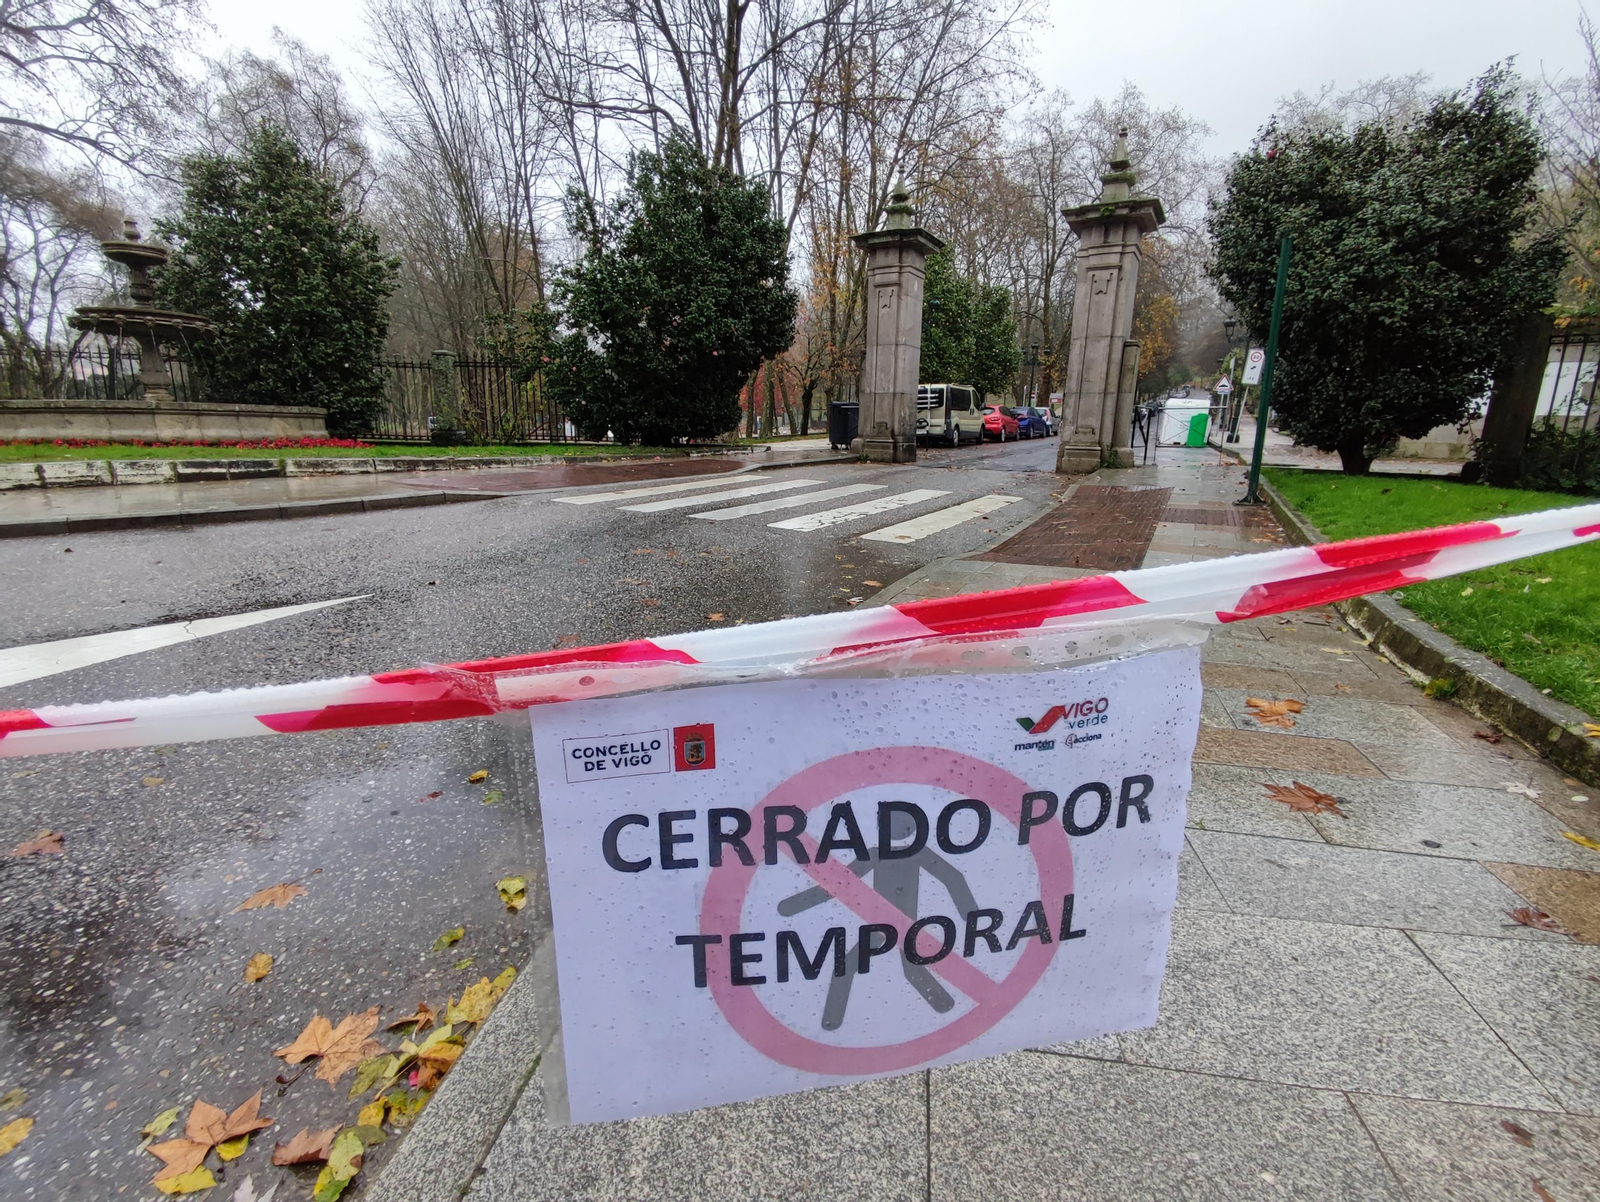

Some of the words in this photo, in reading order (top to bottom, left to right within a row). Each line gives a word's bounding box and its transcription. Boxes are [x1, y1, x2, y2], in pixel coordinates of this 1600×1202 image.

[1062, 697, 1109, 719] VIGO
[1069, 714, 1108, 729] verde
[1073, 733, 1102, 744] acciona
[571, 739, 661, 759] CONCELLO
[584, 760, 606, 772] DE
[612, 753, 652, 768] VIGO
[602, 799, 992, 872] CERRADO
[1017, 774, 1155, 845] POR
[675, 894, 1087, 988] TEMPORAL
